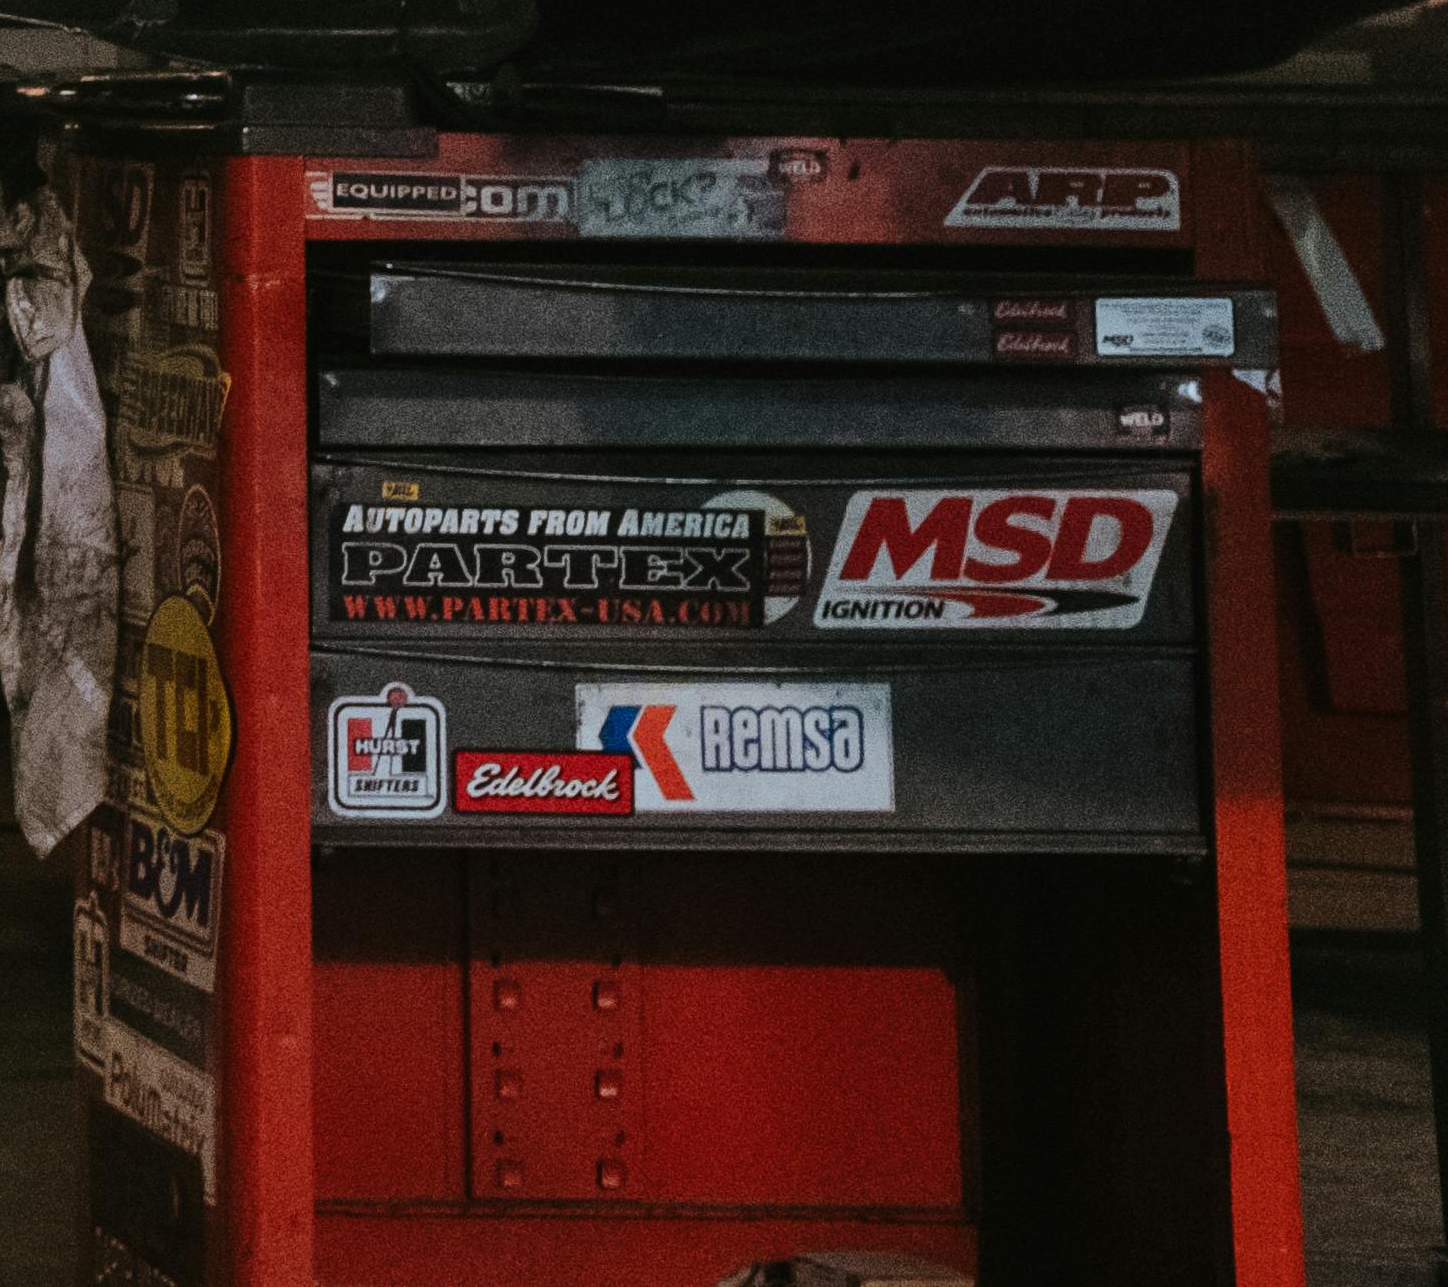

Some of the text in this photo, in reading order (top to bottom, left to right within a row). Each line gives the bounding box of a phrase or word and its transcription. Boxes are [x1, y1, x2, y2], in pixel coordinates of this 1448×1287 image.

[335, 183, 458, 201] EQUIPPED
[965, 171, 1171, 207] ARP
[341, 502, 519, 536] AUTOPARTS
[526, 506, 612, 538] FROM
[617, 506, 751, 540] AMERICA
[839, 496, 1158, 583] MSD
[341, 541, 751, 593] PARTEX
[342, 593, 752, 627] WWW.PARTEX-USA.COM
[822, 597, 946, 622] IGNITION
[354, 738, 421, 756] HURST
[354, 778, 420, 794] SHIFTERS
[464, 761, 621, 802] Edelbrock
